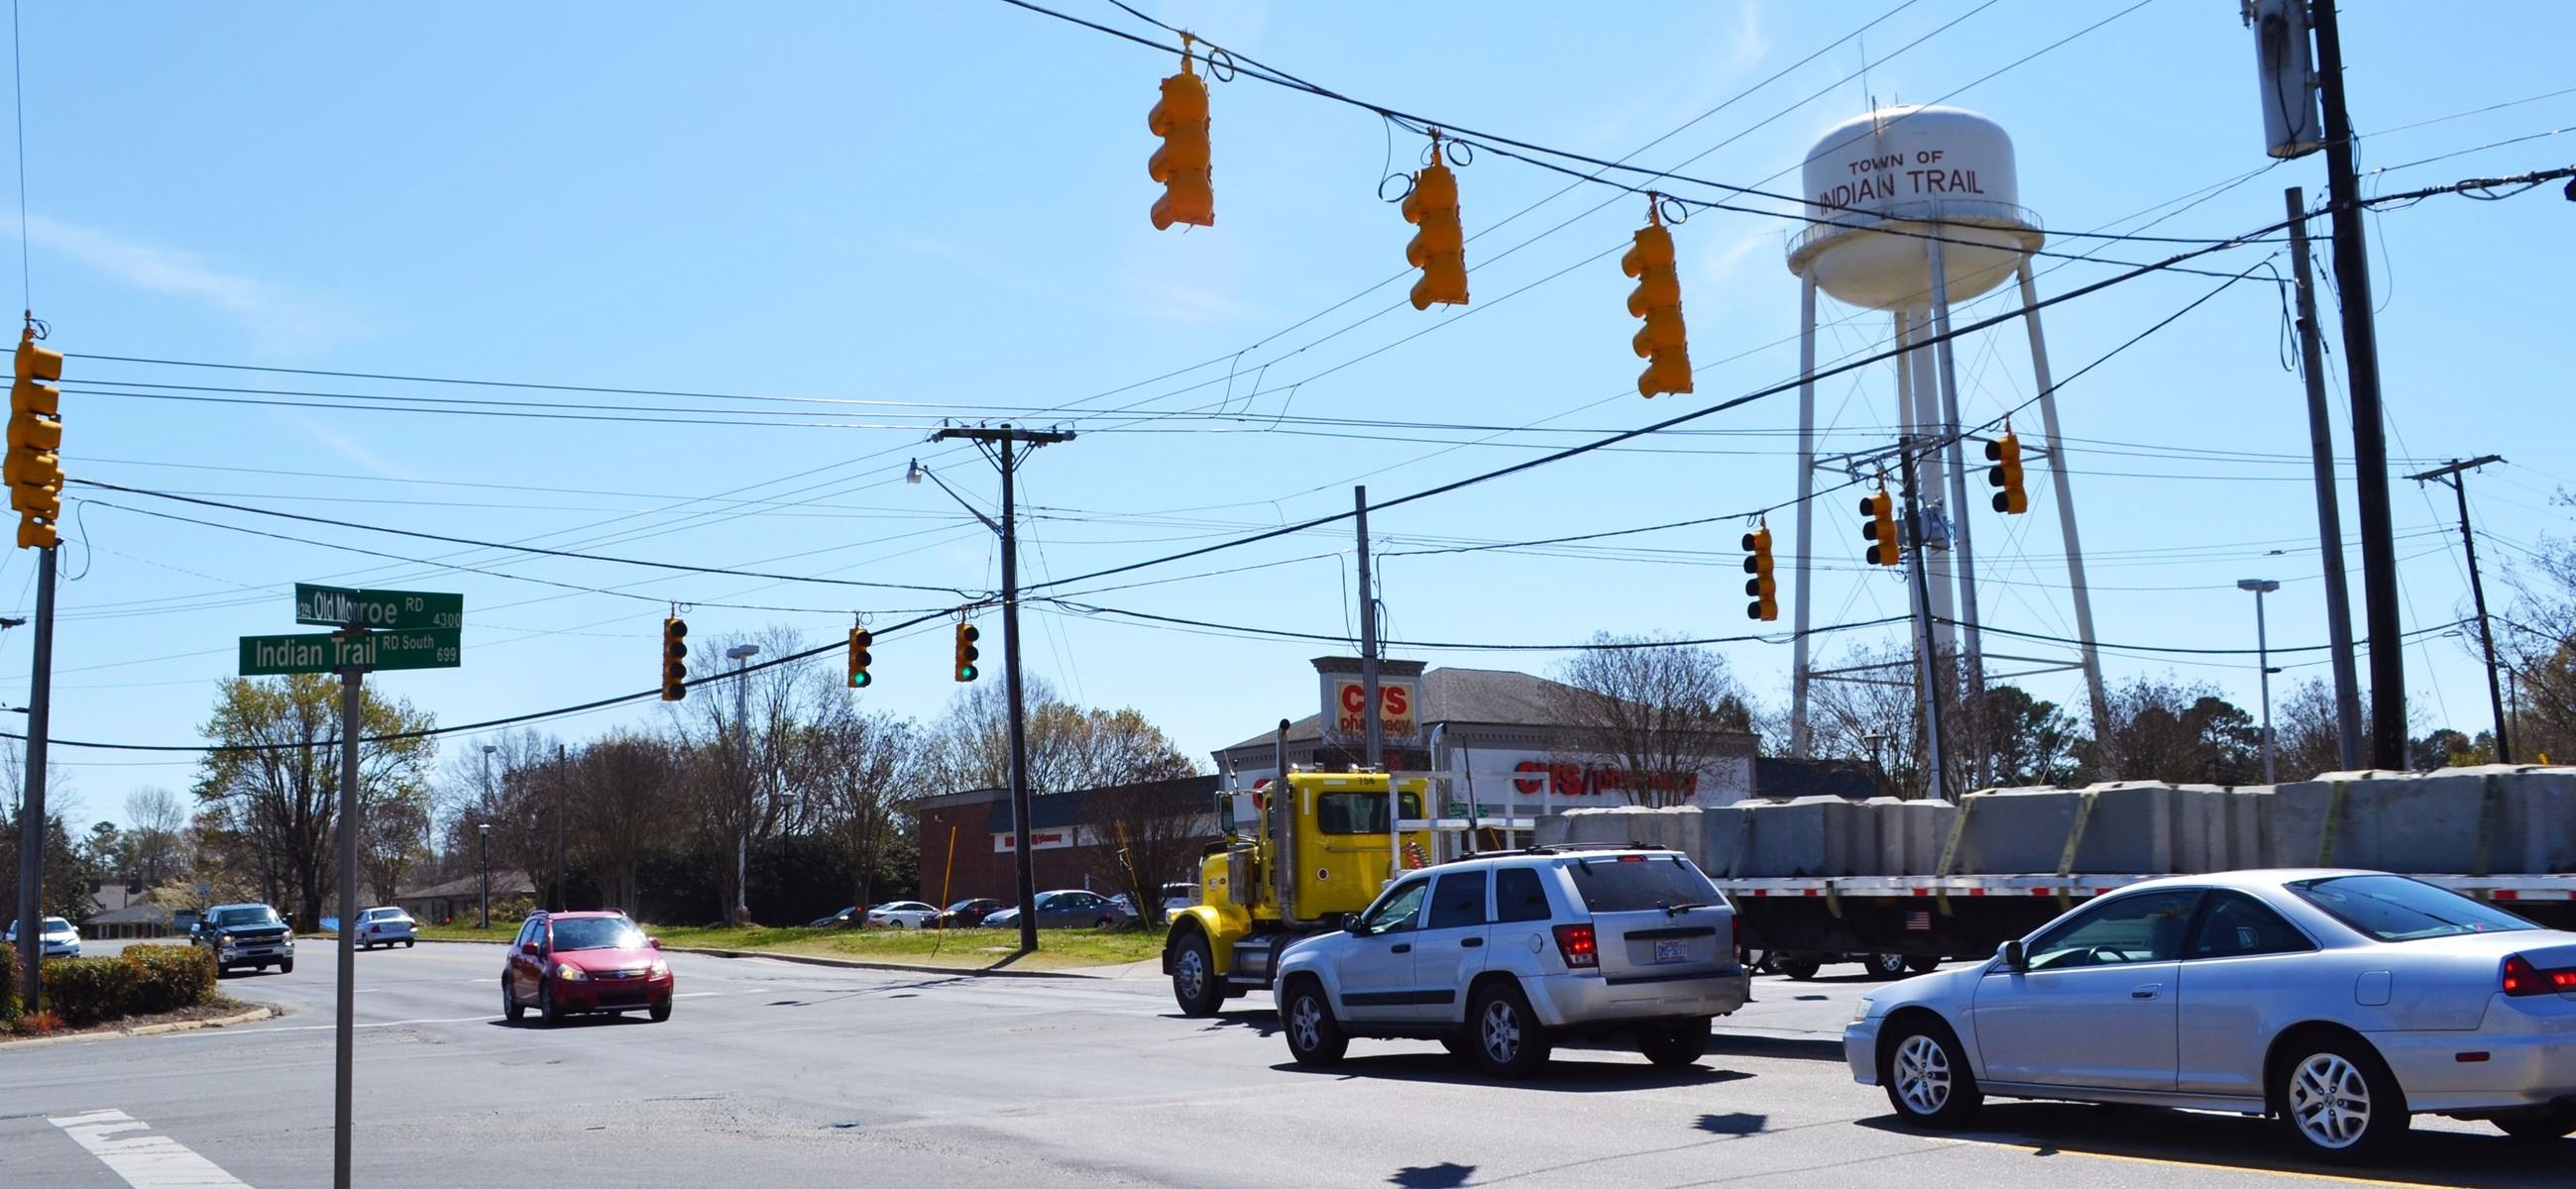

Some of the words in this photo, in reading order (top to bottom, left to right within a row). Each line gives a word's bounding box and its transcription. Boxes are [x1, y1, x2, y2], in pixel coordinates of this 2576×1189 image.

[1848, 153, 1904, 175] TOWN
[1916, 150, 1945, 164] OF
[1819, 172, 1896, 216] INDIAN
[1907, 169, 1984, 195] TRAIL
[314, 591, 334, 619] Old
[337, 594, 397, 624] Monroe
[405, 596, 424, 612] RD
[433, 612, 462, 629] 4300
[256, 639, 323, 668] Indian
[331, 636, 377, 666] Trail
[383, 635, 398, 650] RD
[401, 634, 434, 650] South
[436, 646, 457, 662] 699
